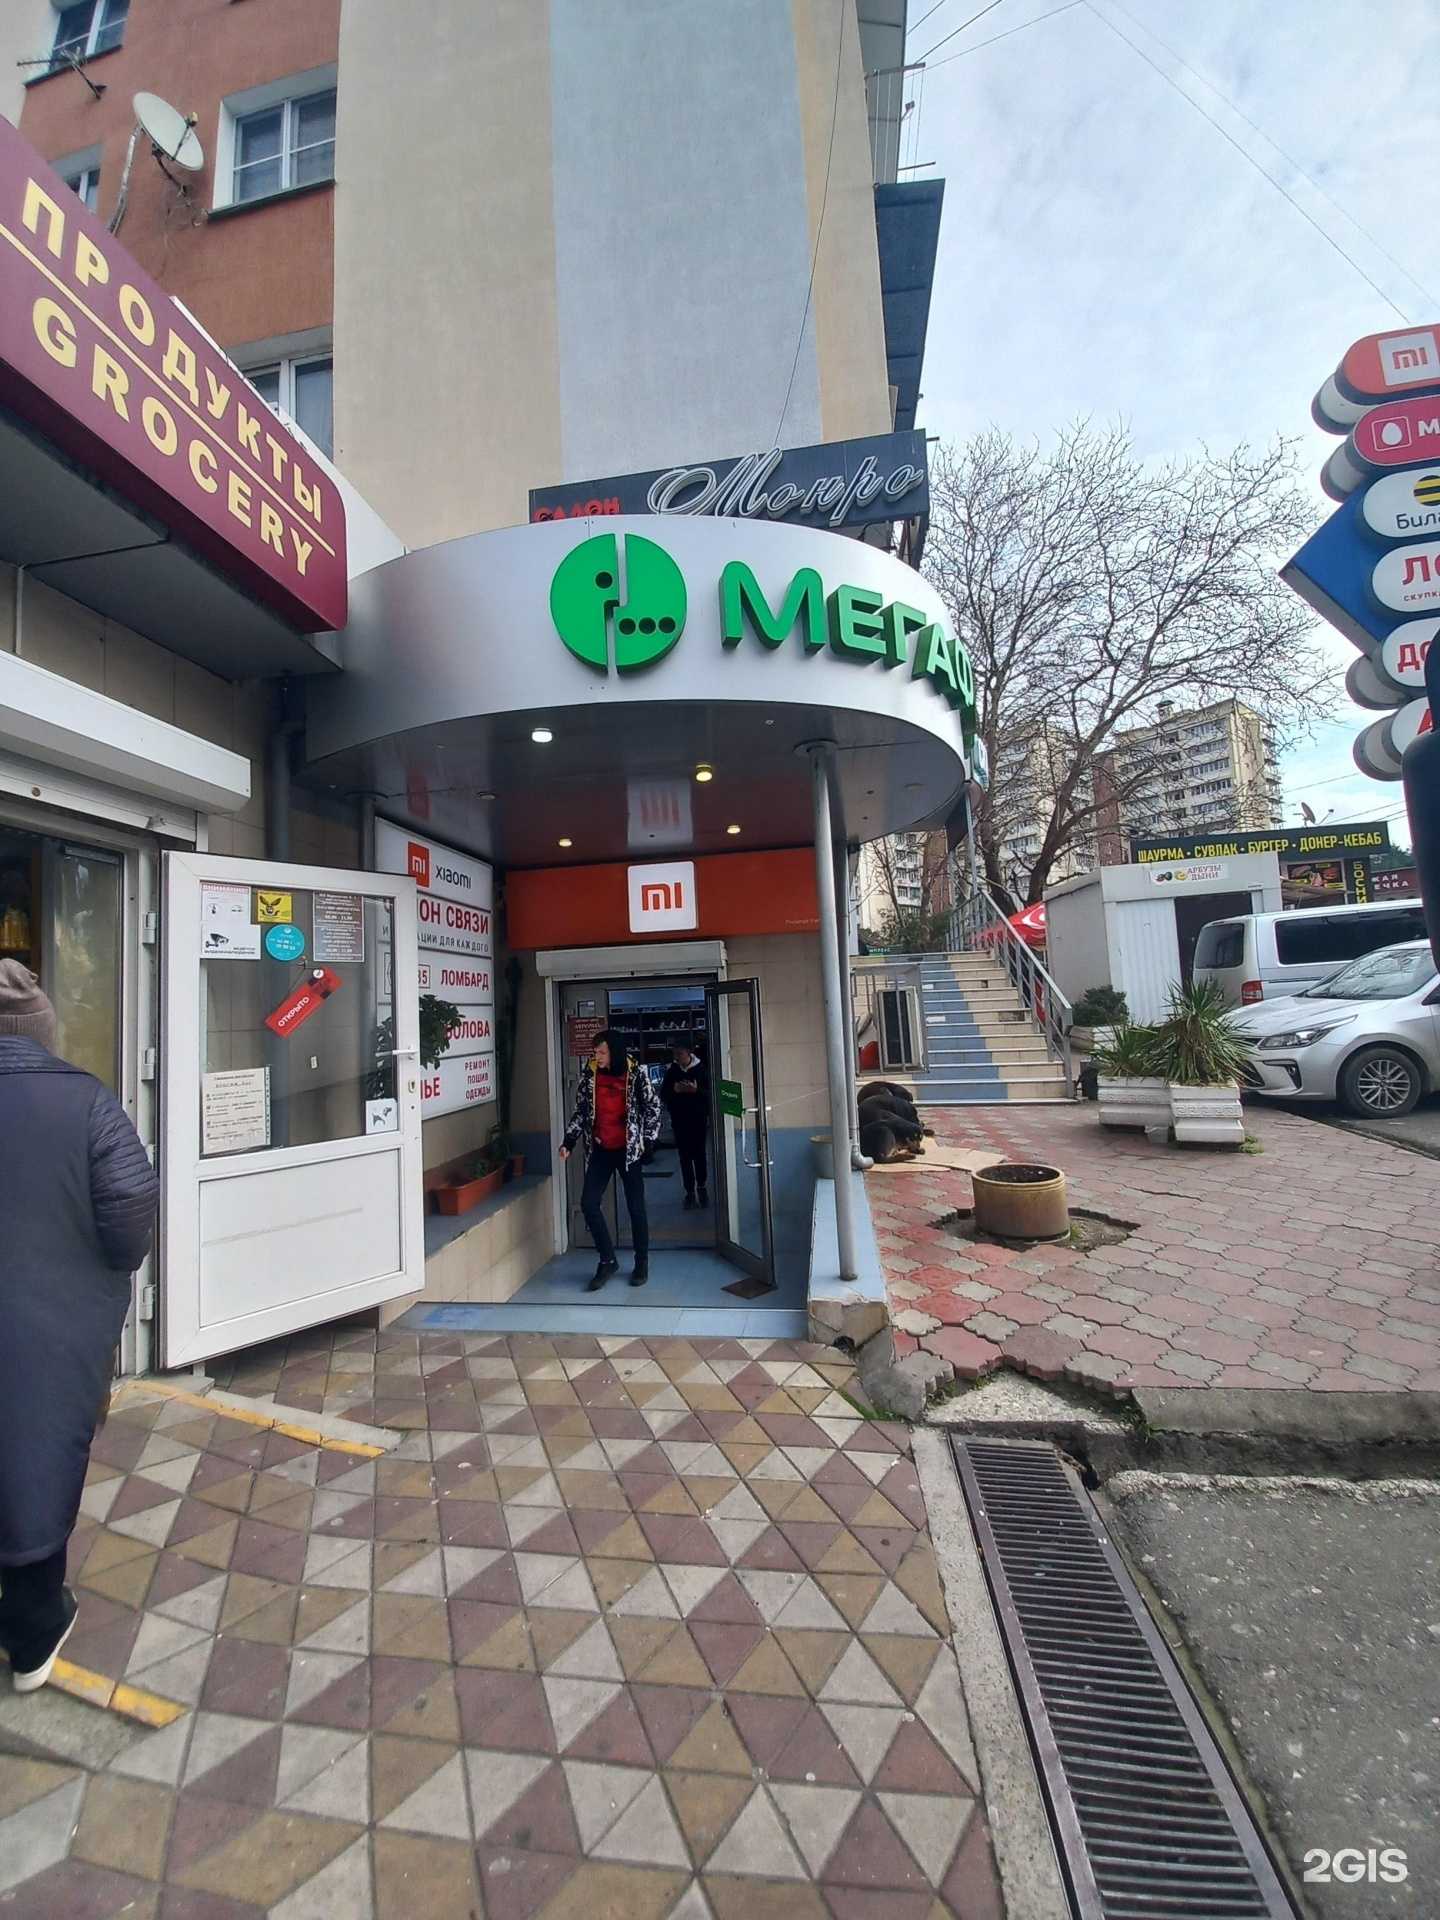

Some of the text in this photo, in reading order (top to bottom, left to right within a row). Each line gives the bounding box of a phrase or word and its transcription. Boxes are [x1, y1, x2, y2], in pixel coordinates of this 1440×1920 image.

[21, 178, 322, 523] ПРОДУКТЫ
[32, 297, 312, 577] GROCERY
[1396, 512, 1440, 530] Бил
[1403, 591, 1440, 601] СКУПК
[1138, 832, 1382, 862] ШАУРМА СУВЛАК БУРГЕР ДОНЕР-КЕБАБ
[1187, 864, 1221, 874] АРБУЗЫ
[446, 905, 489, 935] СВЯЗИ
[439, 935, 455, 947] ДЛЯ
[441, 969, 489, 991] ЛОМБАРД
[278, 996, 310, 1027] ОТКРЫТО
[465, 1059, 490, 1071] РЕМОНТ
[467, 1072, 489, 1084] ПОШИВ
[465, 1086, 491, 1101] ОДЕЖДЫ
